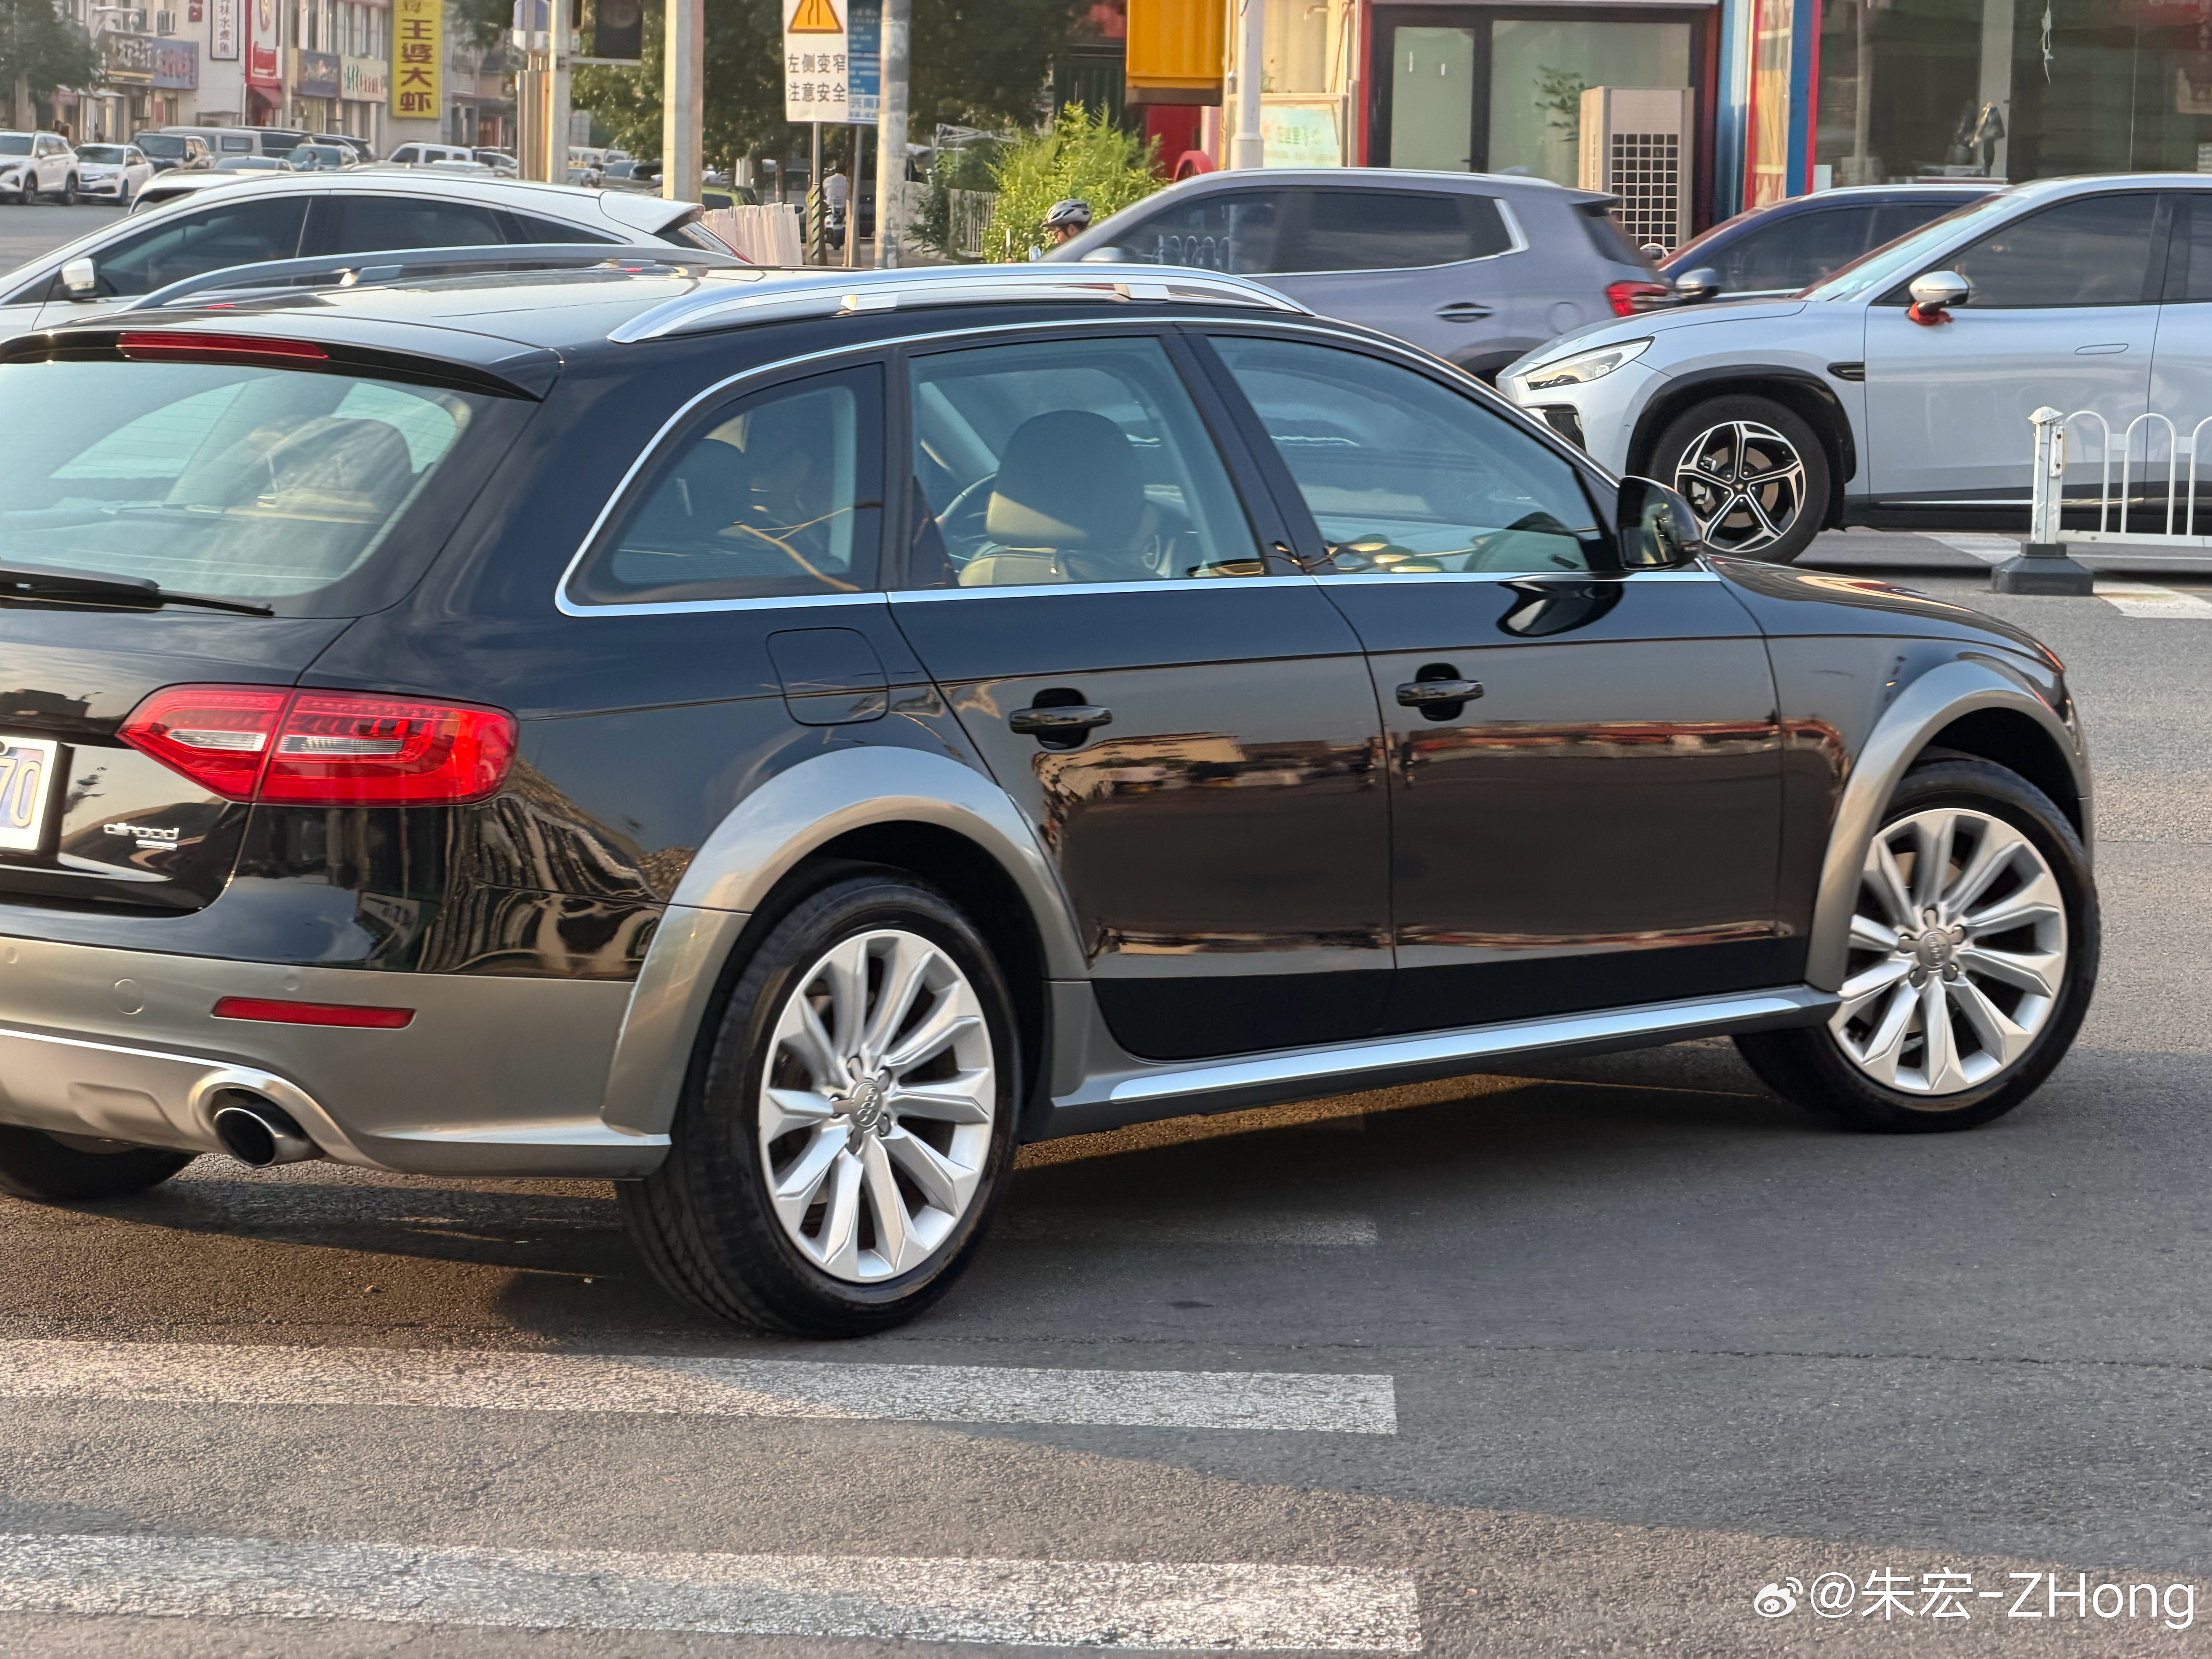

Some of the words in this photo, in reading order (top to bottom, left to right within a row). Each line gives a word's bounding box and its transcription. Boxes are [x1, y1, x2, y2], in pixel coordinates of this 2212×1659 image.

[787, 53, 846, 73] 左侧变窄
[788, 82, 846, 102] 注意安全
